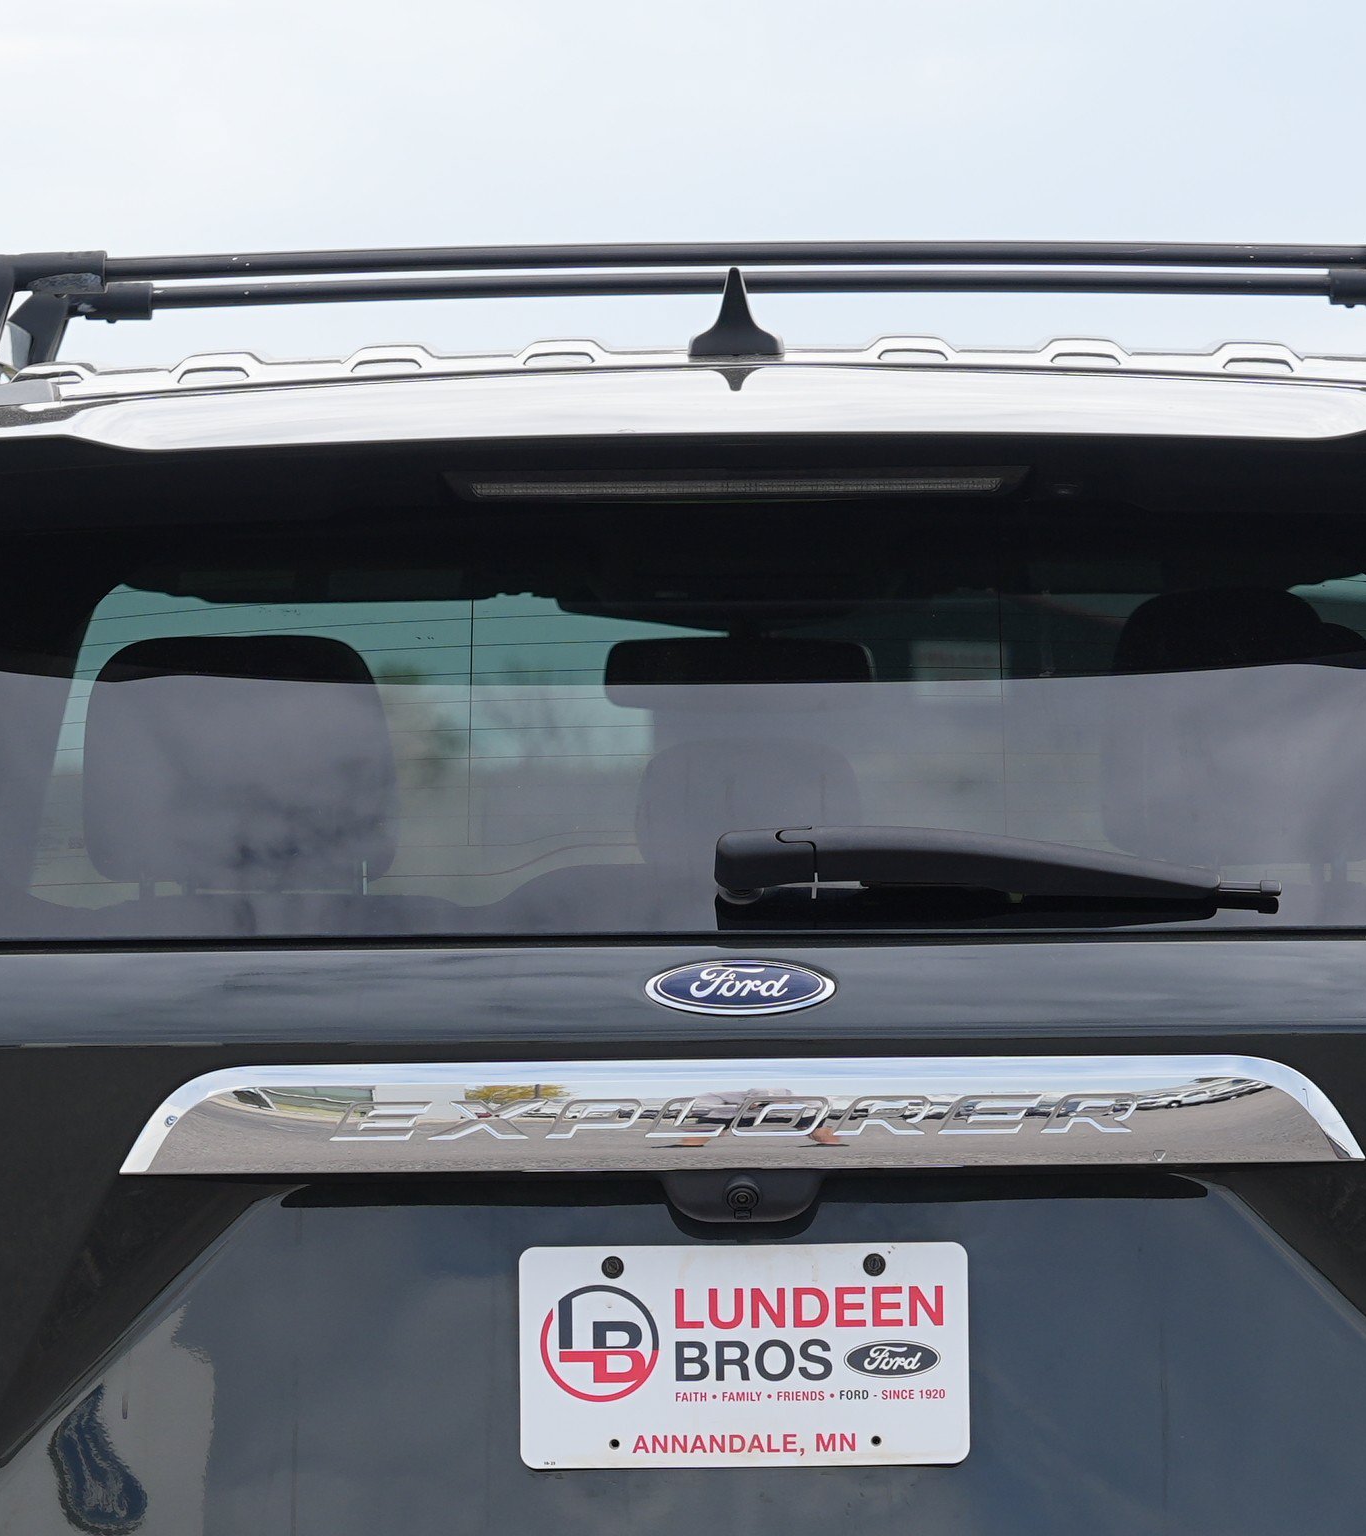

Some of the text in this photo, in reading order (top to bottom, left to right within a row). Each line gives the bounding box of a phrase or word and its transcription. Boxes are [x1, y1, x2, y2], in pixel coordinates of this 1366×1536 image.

[690, 965, 791, 998] Ford
[329, 1092, 1139, 1143] EXPLORER
[674, 1285, 944, 1330] LUNDEEN
[675, 1338, 922, 1382] BROS Ford
[675, 1388, 946, 1402] FAITH FAMILY FRIENDS FORD SINCE 1920
[632, 1432, 857, 1456] ANNANDALE, MN
